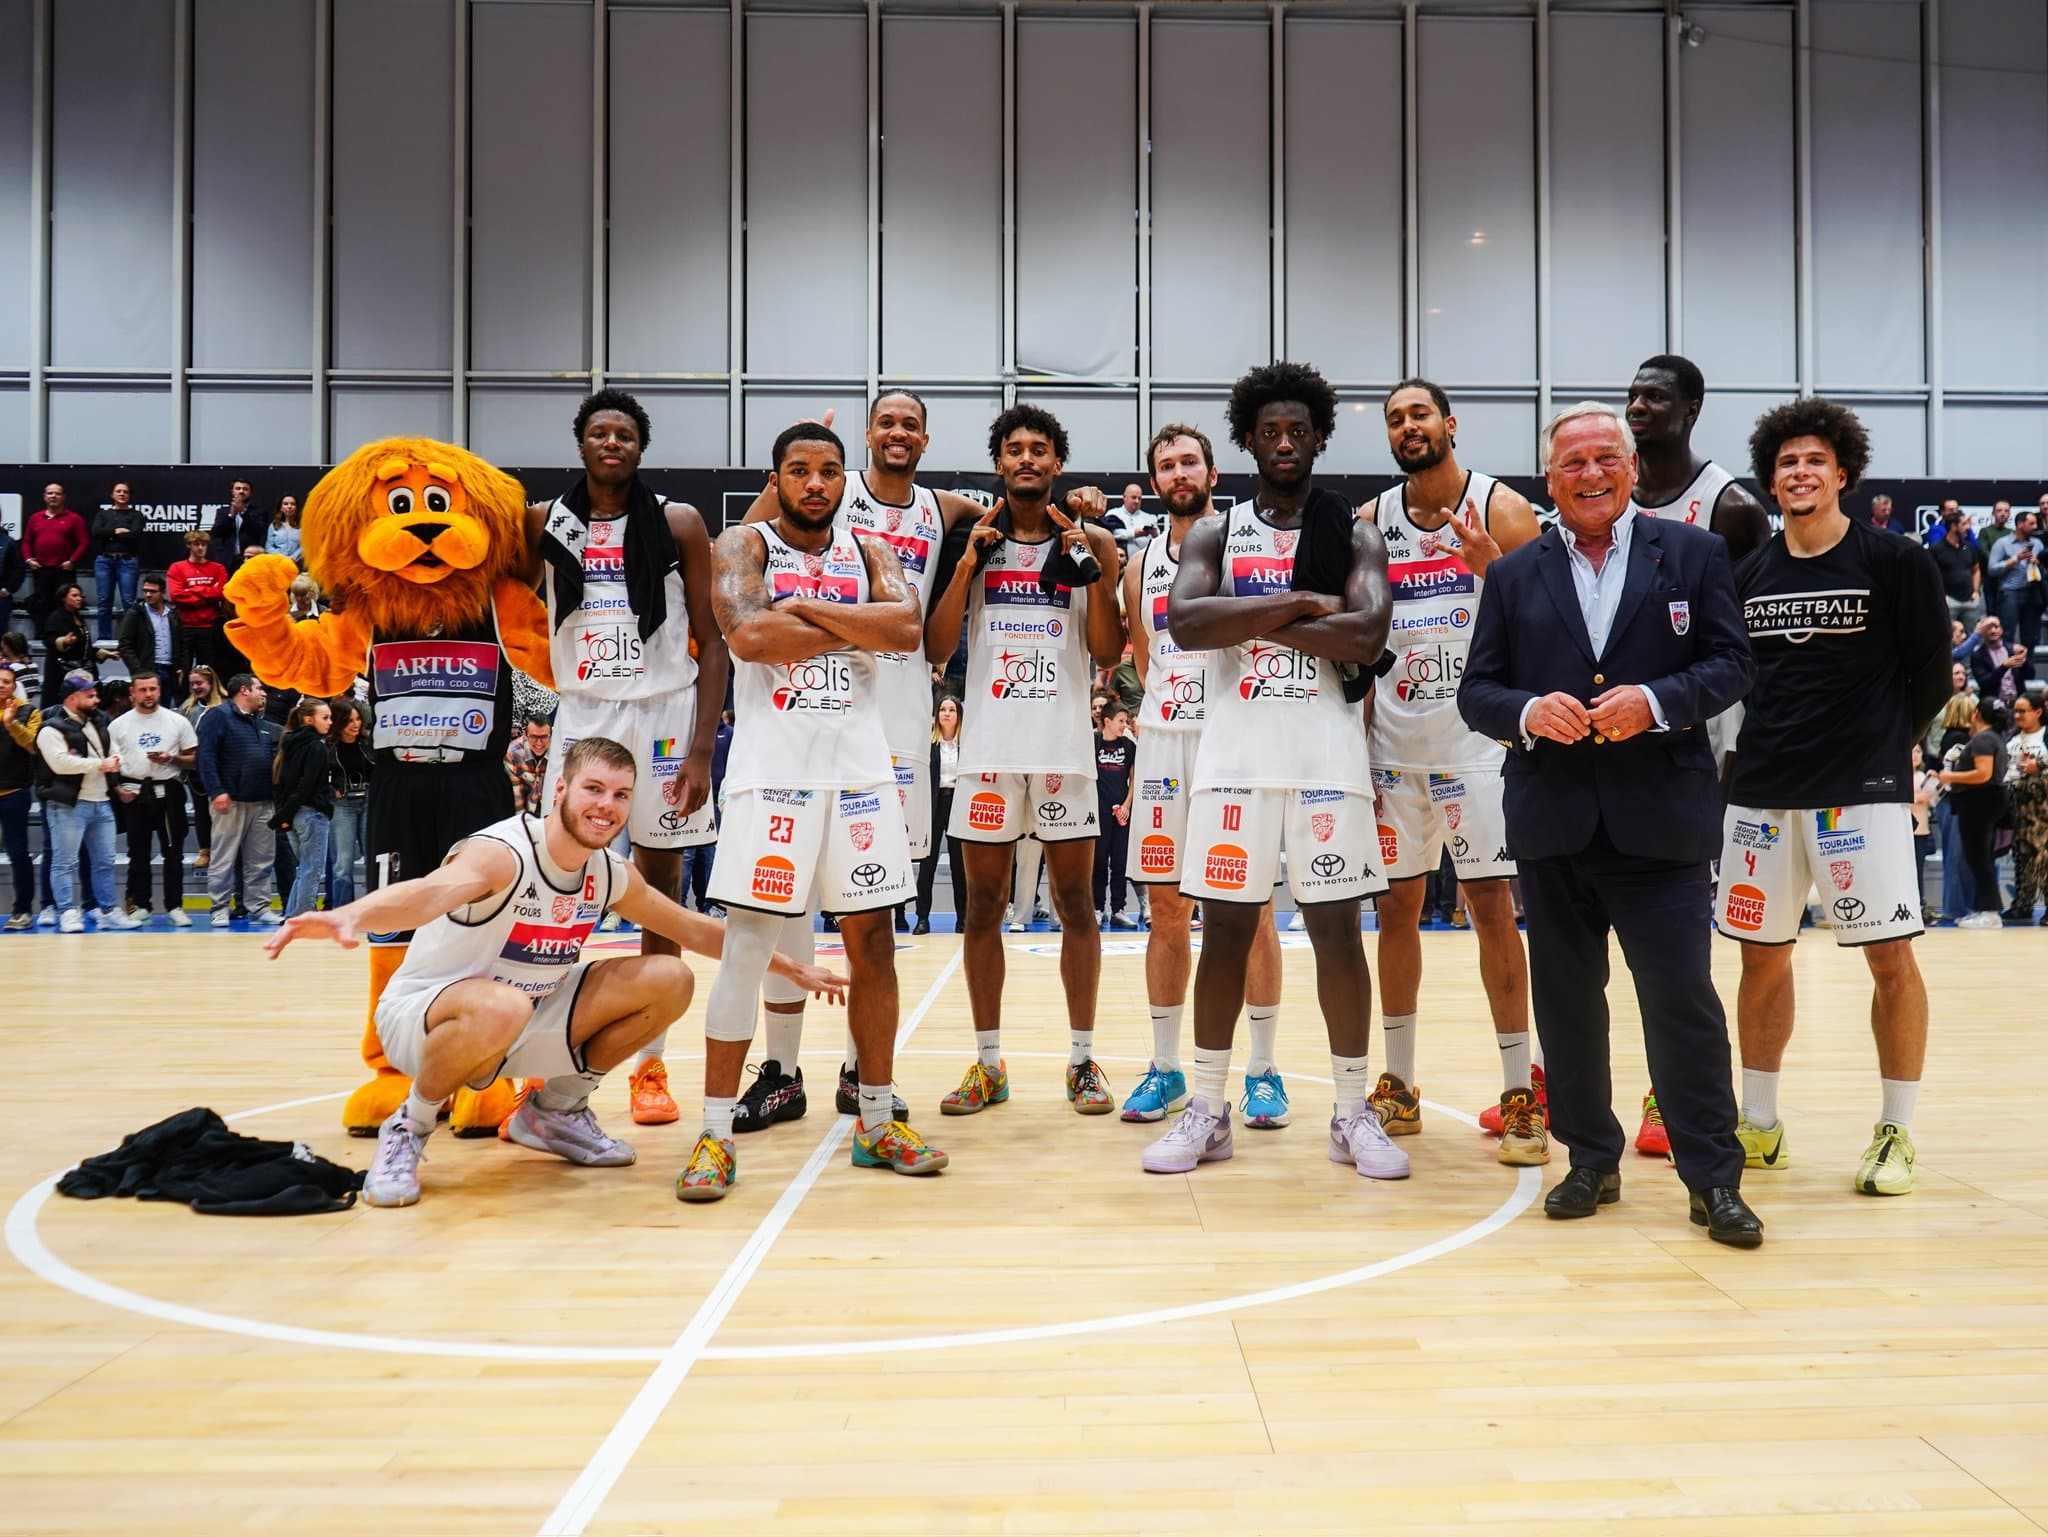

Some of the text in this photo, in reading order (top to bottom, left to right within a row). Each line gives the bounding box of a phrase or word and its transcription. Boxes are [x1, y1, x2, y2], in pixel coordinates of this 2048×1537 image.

[1685, 501, 1701, 524] 5
[143, 522, 197, 532] RTEMENT
[846, 514, 876, 528] TOURS
[891, 545, 916, 560] TUS
[582, 557, 625, 572] RTU
[988, 556, 1007, 565] URS
[1248, 567, 1294, 586] ART
[1400, 567, 1457, 588] ARTUS
[1147, 582, 1173, 595] TOURS
[1414, 588, 1437, 598] interim
[1011, 595, 1035, 604] interim
[1744, 599, 1869, 619] BASKETBALL
[990, 620, 1045, 633] E.Leclerc
[1392, 616, 1448, 630] E.Leclerc
[1747, 616, 1864, 629] TRAINING CAMP
[1004, 632, 1045, 640] FONDETTES
[1407, 627, 1449, 637] FONDETTES
[393, 656, 478, 677] ARTUS
[411, 677, 445, 688] interim
[473, 680, 488, 688] CDI
[1239, 676, 1320, 703] TOLÉDIF
[1161, 700, 1205, 722] TOLÉ
[380, 713, 460, 728] E.Leclerc
[397, 729, 459, 737] FONDETTES
[652, 763, 682, 771] TOURA
[763, 788, 791, 798] CENTRE
[1430, 783, 1465, 797] TOURAINE
[762, 794, 775, 803] VAL
[775, 796, 786, 804] DE
[840, 797, 880, 812] TOURAINE
[970, 802, 1006, 814] BURGER
[969, 810, 1005, 825] KING
[1153, 806, 1162, 829] 8
[1223, 804, 1242, 831] 10
[769, 815, 795, 844] 23
[1379, 837, 1397, 846] GER
[1818, 835, 1865, 851] TOURAINE
[1141, 846, 1175, 855] BURGER
[1826, 844, 1865, 856] DÉPARTEMENT
[1141, 854, 1175, 867] KING
[1206, 856, 1247, 870] BURGER
[1745, 850, 1757, 877] 4
[754, 867, 795, 882] BURGER
[1205, 866, 1247, 882] KING
[1324, 876, 1358, 886] MOTORS
[584, 875, 595, 901] 6
[752, 877, 794, 896] KING
[842, 884, 900, 899] TOYS MOTORS
[1728, 895, 1765, 912] BURGER
[513, 904, 542, 918] TOURS
[1726, 905, 1764, 924] KING
[1847, 920, 1882, 929] MOTORS
[522, 937, 582, 955] ARTUS
